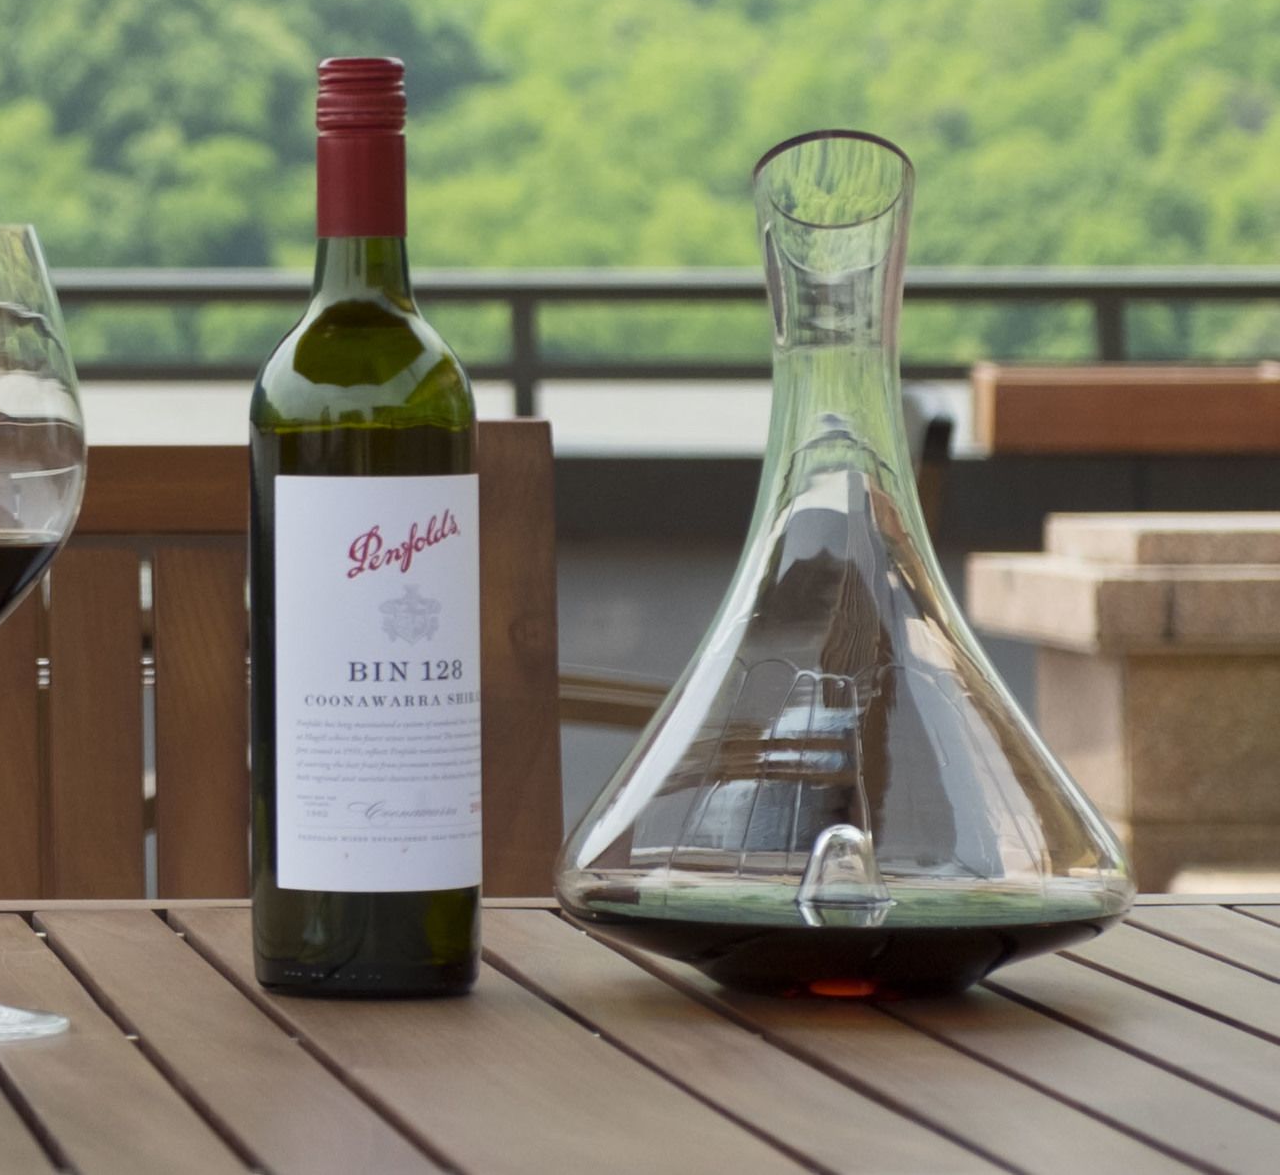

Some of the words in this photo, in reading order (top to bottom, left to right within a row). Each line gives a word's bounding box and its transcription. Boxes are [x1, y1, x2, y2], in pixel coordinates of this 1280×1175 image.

[348, 661, 409, 682] BIN
[421, 659, 463, 681] 128
[304, 694, 441, 707] COONAWARRA
